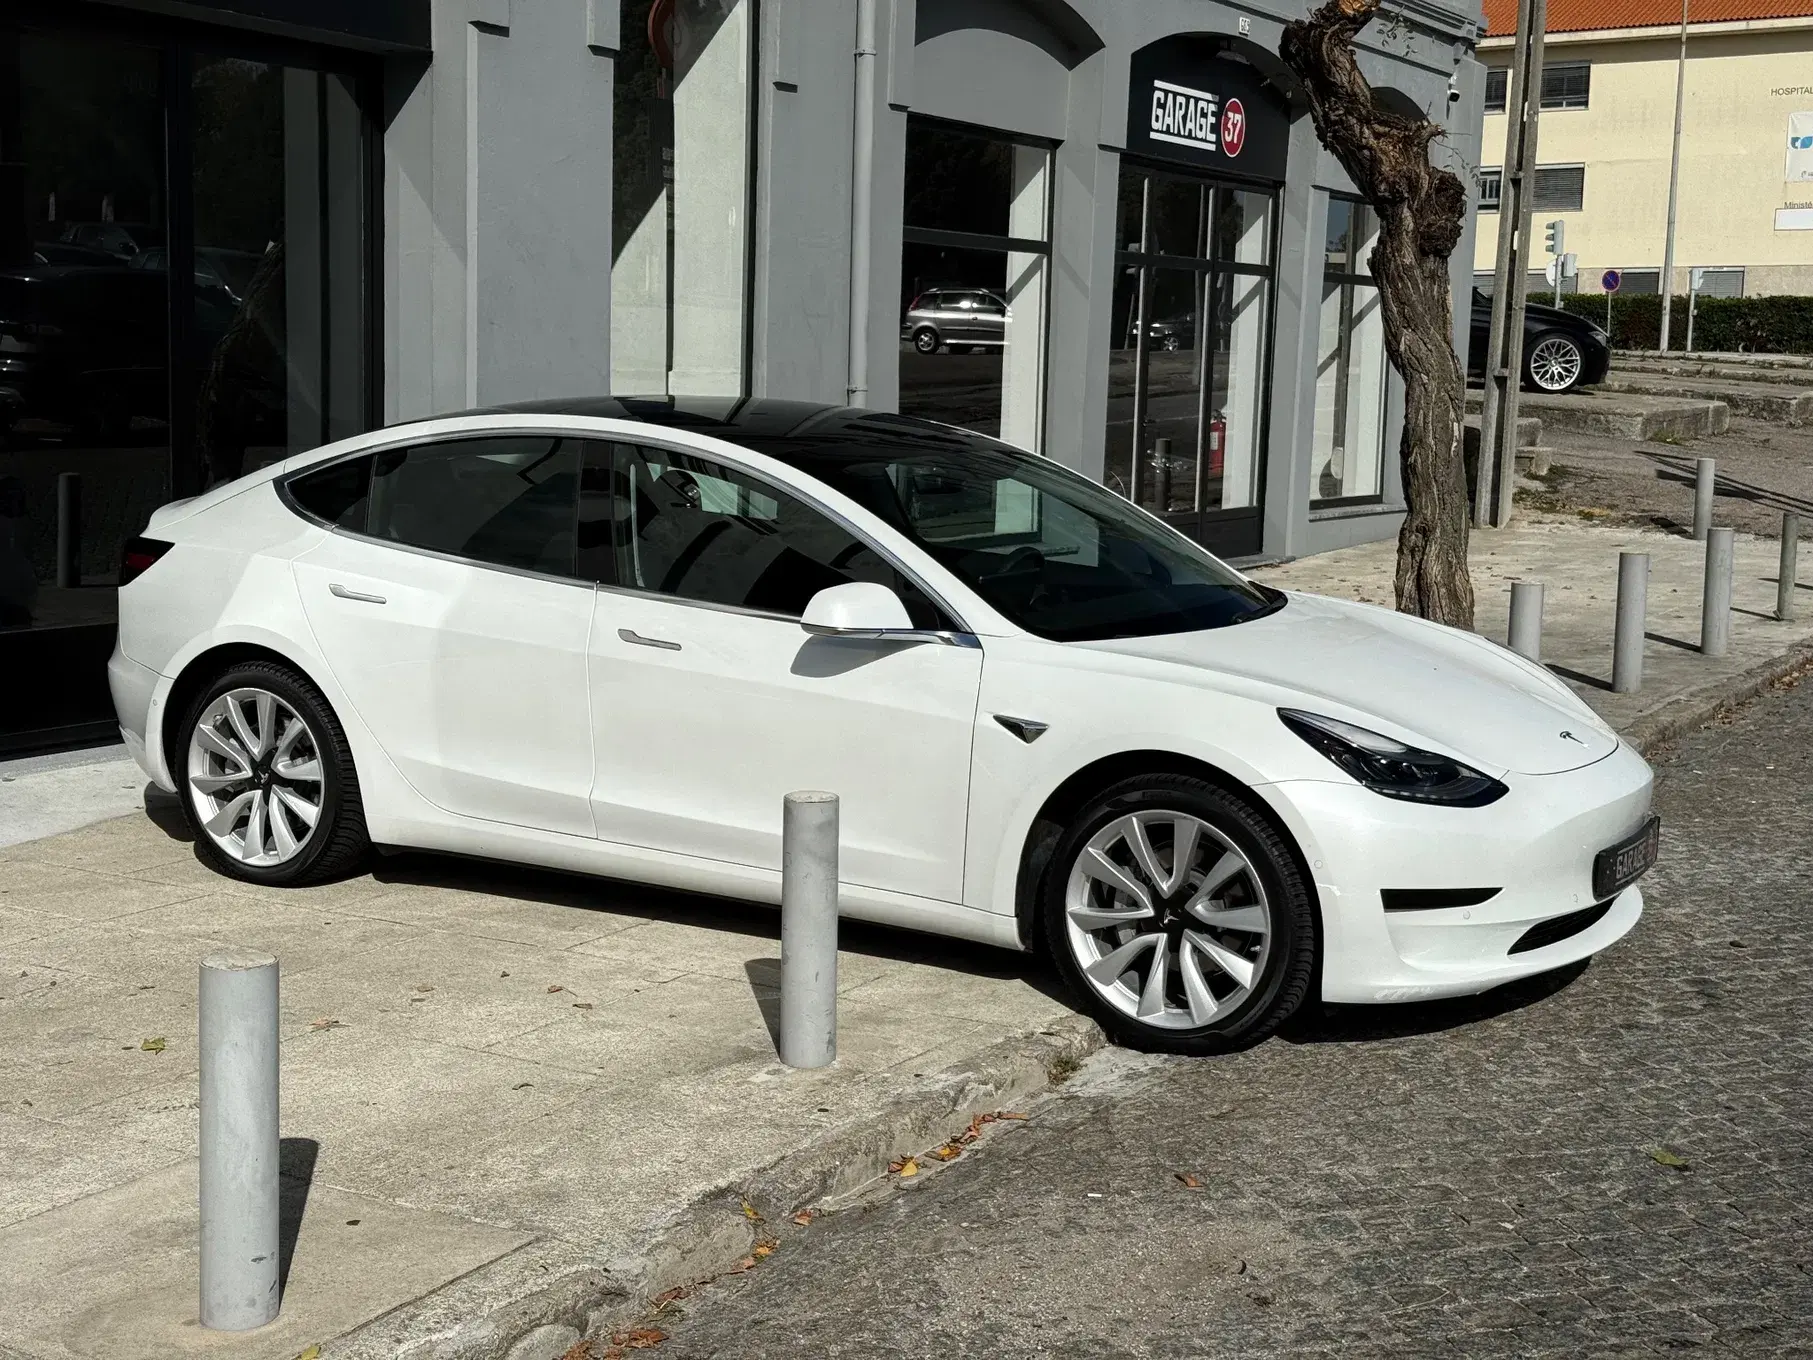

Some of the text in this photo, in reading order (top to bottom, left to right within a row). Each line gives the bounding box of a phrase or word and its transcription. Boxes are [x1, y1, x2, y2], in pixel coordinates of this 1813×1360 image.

[1770, 87, 1813, 96] HOSPITAL
[1151, 90, 1242, 144] GARAGE 37
